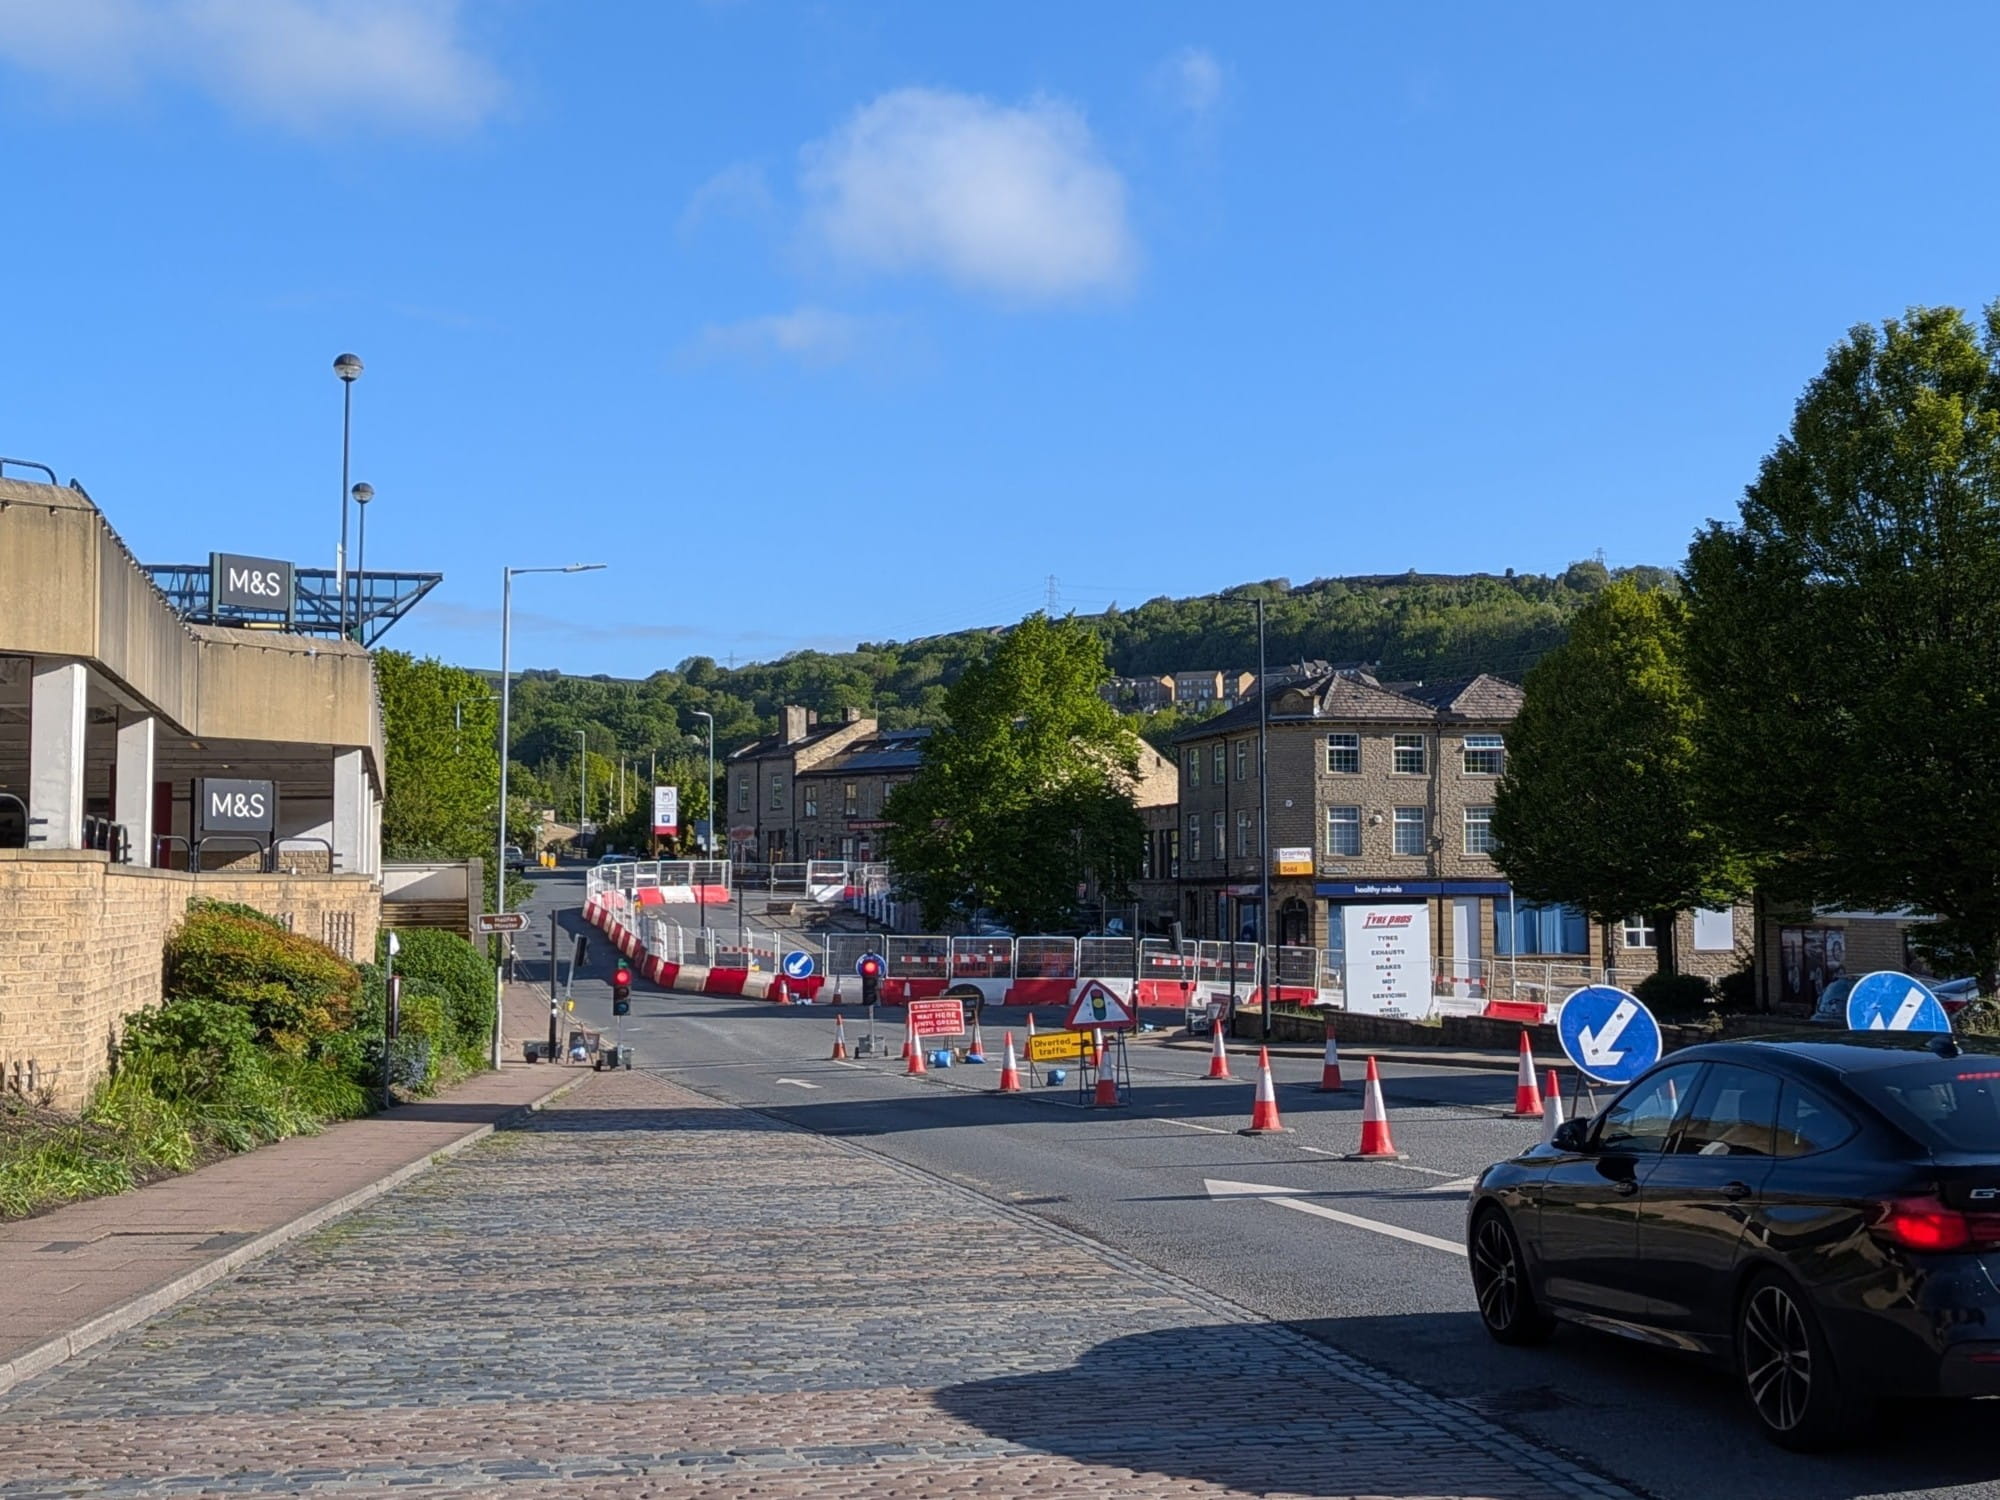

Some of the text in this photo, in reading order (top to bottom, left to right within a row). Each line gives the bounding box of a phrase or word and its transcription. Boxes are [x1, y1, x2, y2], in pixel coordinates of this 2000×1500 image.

[229, 567, 281, 597] M&S
[211, 792, 265, 818] M&S
[1282, 865, 1298, 873] Sold
[1354, 885, 1402, 894] healthy minds
[1034, 1038, 1071, 1048] Diverted
[1039, 1047, 1067, 1055] traffic
[1970, 1188, 2000, 1199] G
